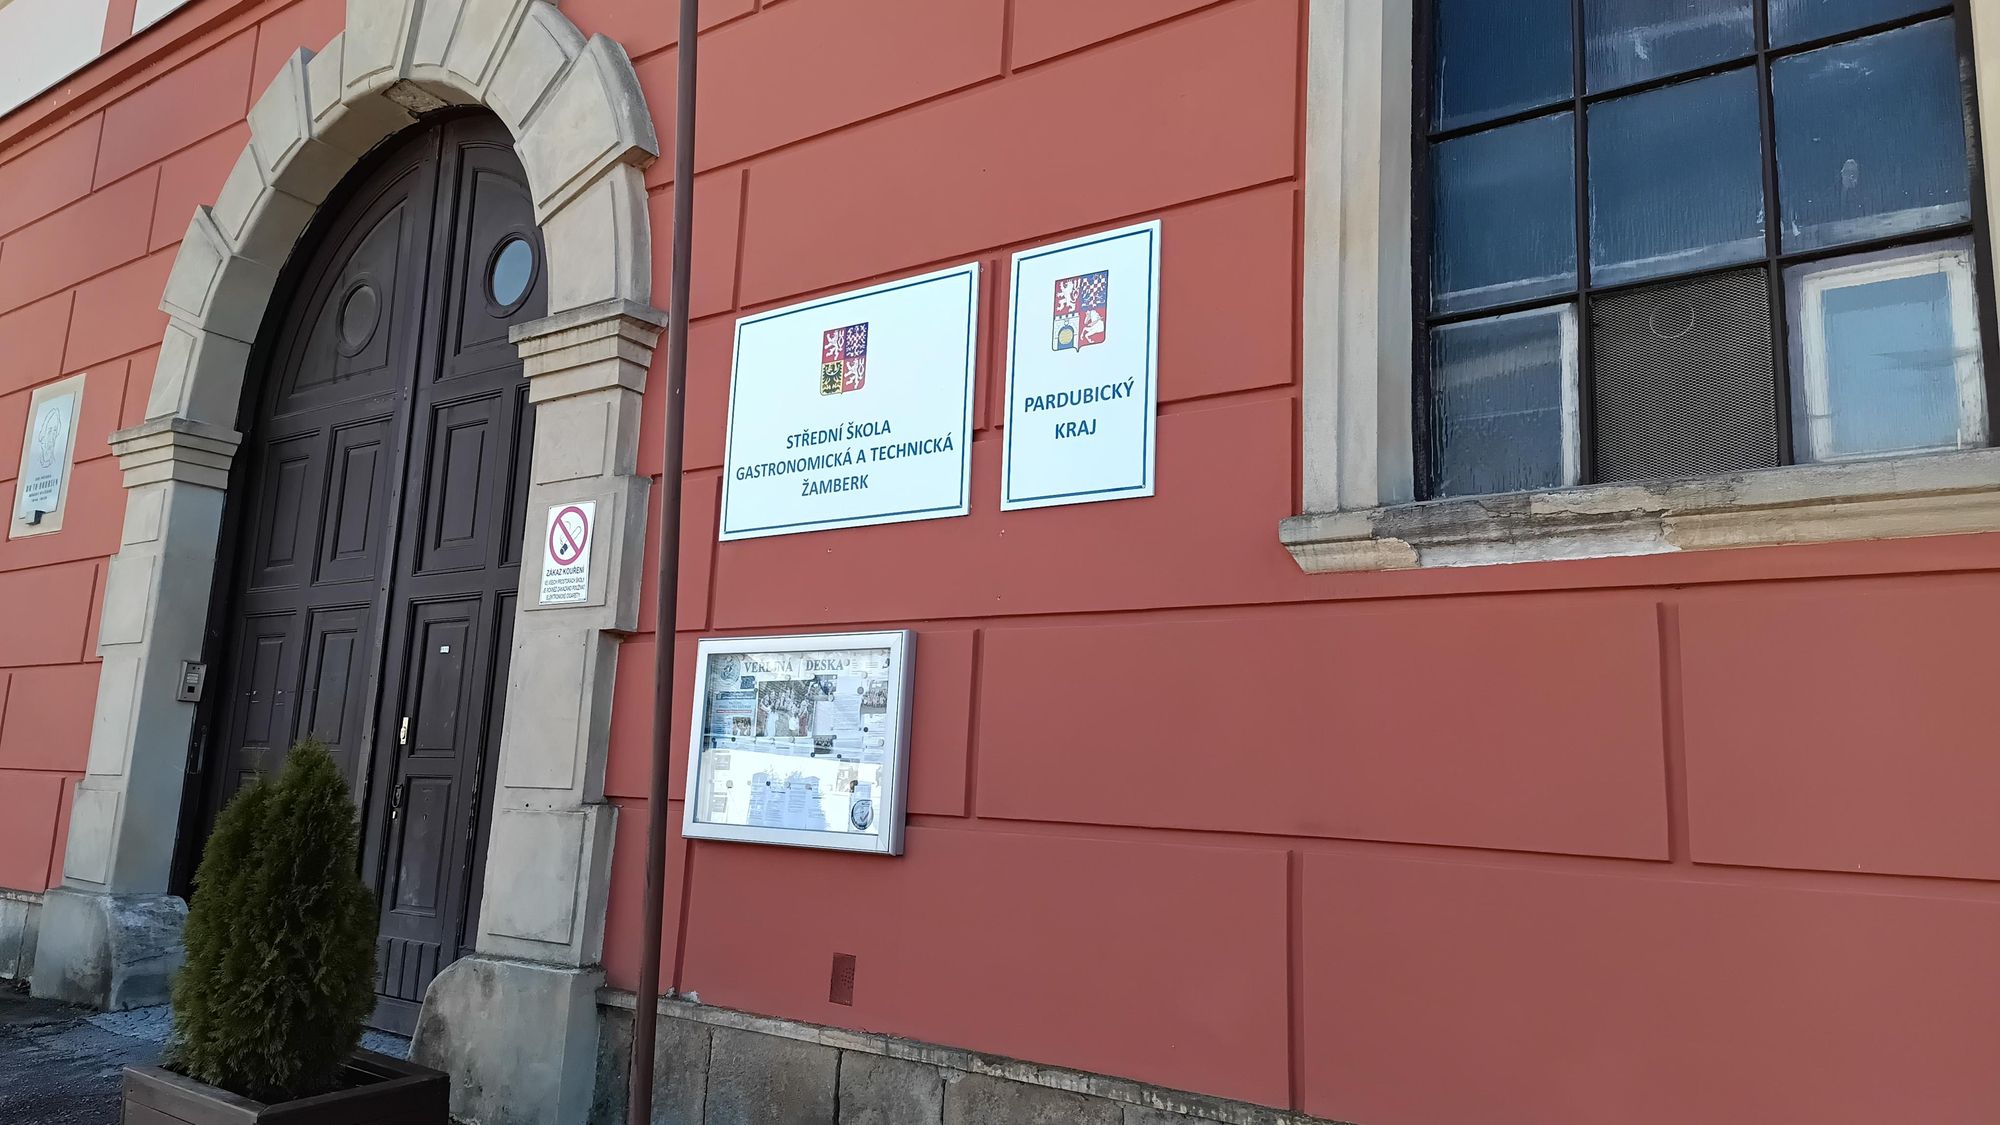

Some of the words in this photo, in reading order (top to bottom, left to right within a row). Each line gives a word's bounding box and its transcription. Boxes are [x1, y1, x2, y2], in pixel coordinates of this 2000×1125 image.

[1024, 376, 1135, 413] PARDUBICKÝ
[786, 422, 844, 449] STŘEDNÍ
[846, 419, 892, 440] ŠKOLA
[1055, 418, 1097, 440] KRAJ
[736, 447, 853, 481] GASTRONOMICKÁ
[856, 449, 867, 464] A
[870, 432, 954, 462] TECHNICKÁ
[801, 474, 869, 497] ŽAMBERK
[546, 568, 562, 576] ZÁKAZ
[563, 566, 585, 575] KOUŘENÍ
[806, 659, 844, 671] DESKA
